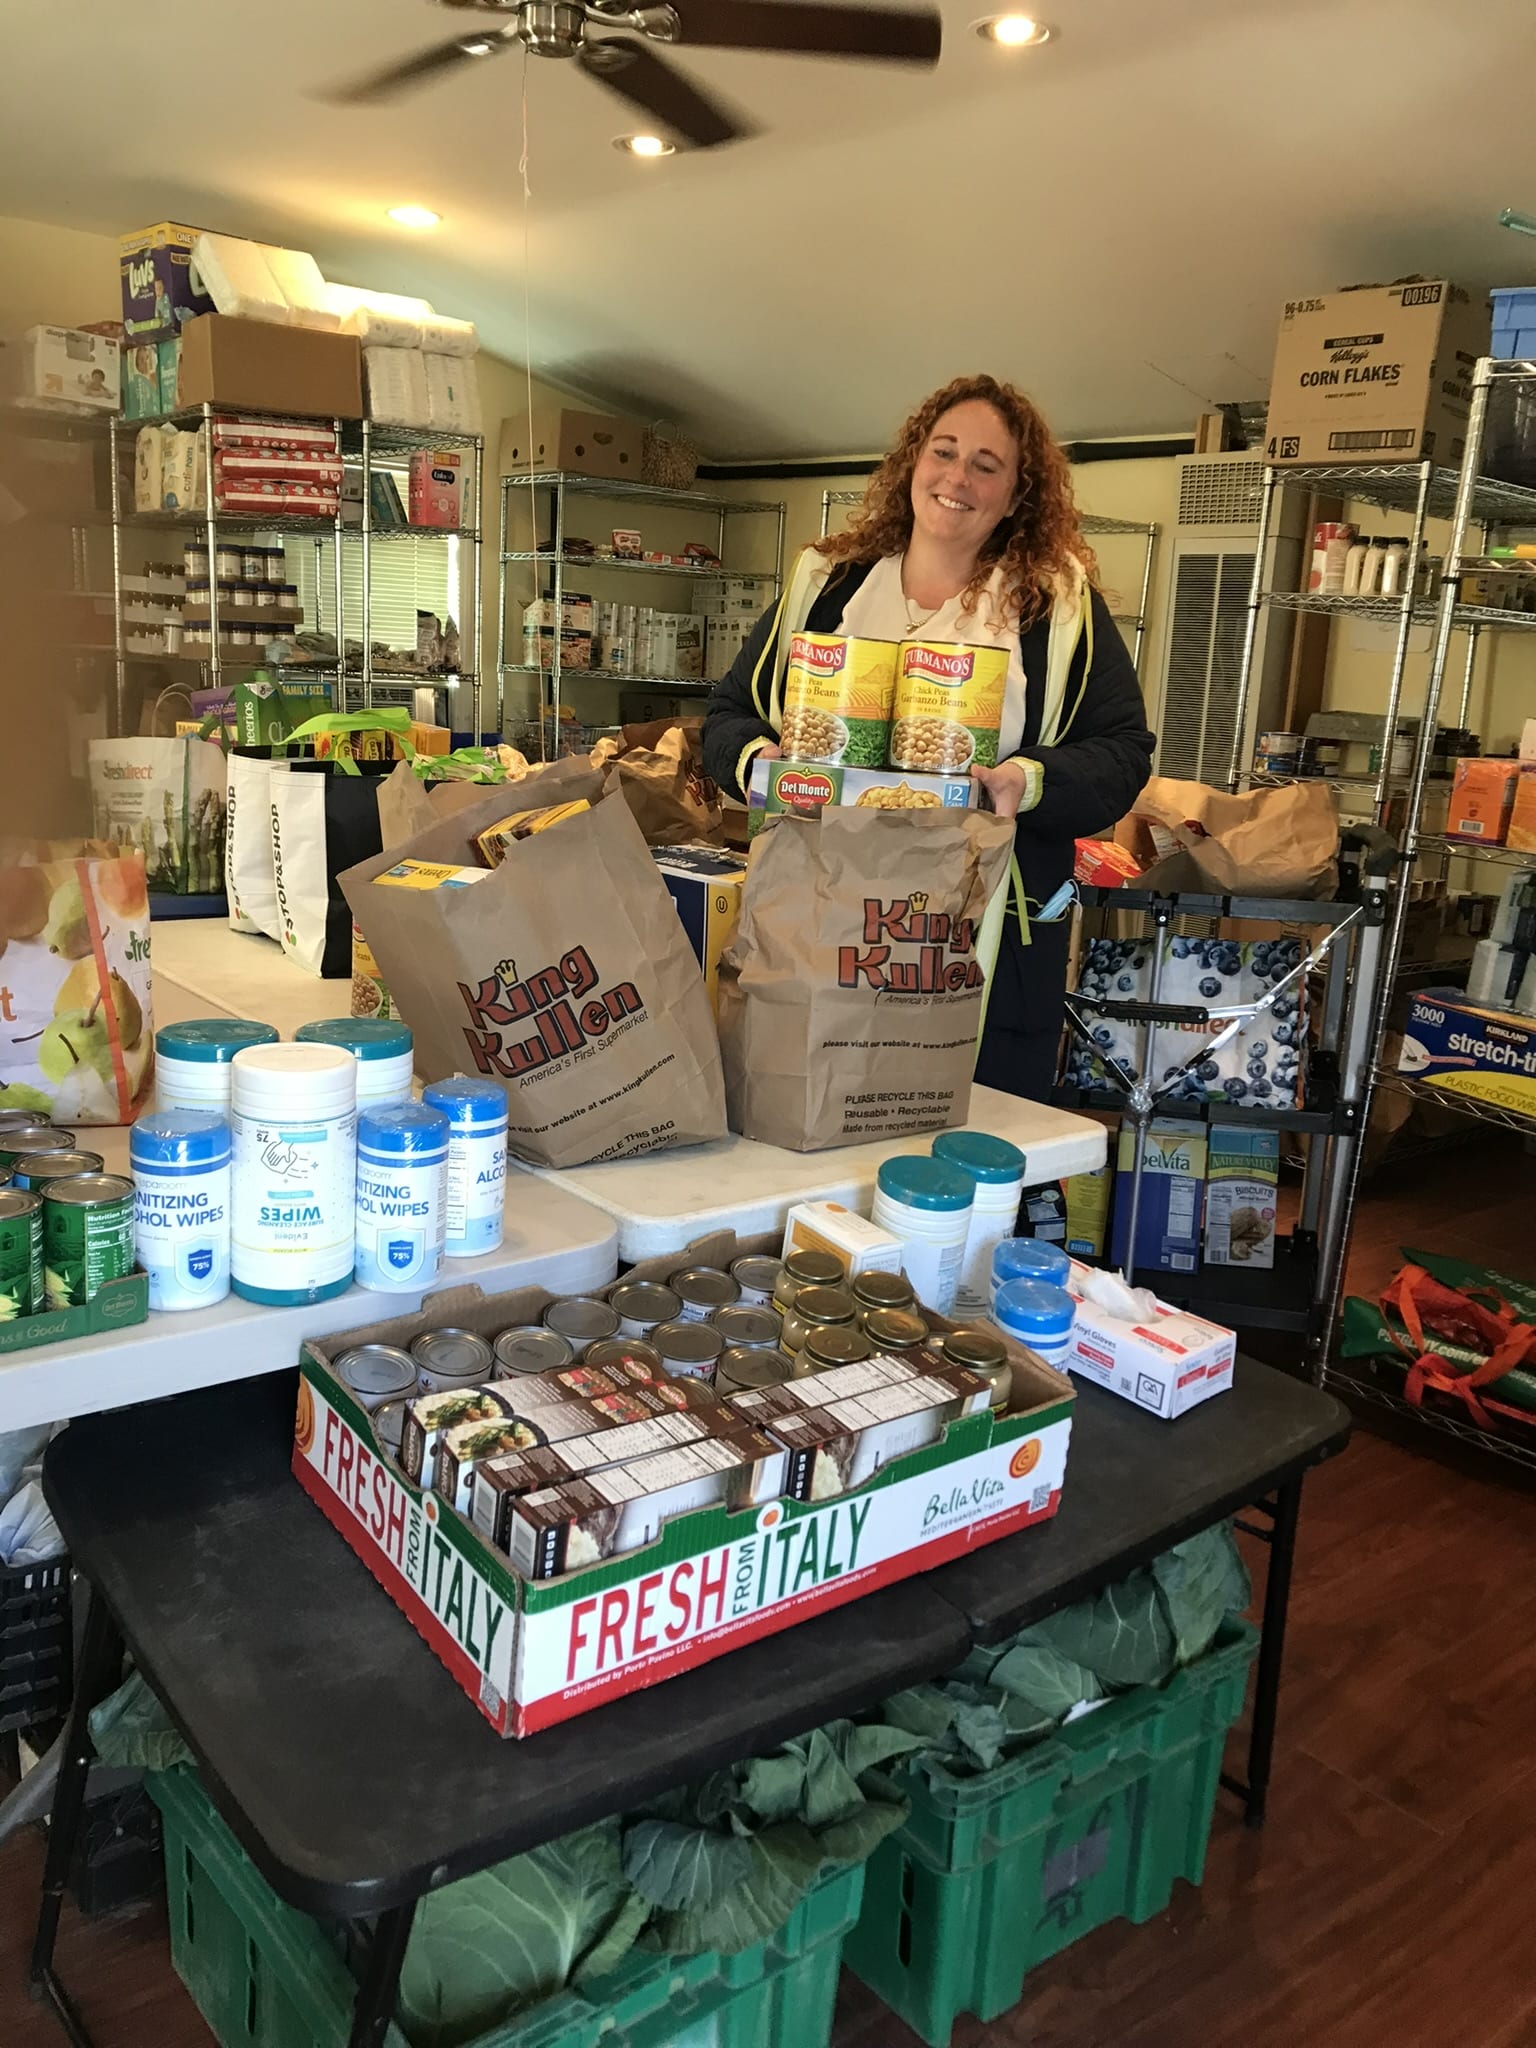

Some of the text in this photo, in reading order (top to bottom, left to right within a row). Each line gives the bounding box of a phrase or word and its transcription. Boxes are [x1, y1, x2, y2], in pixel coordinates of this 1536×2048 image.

[1404, 286, 1440, 305] 00196
[1333, 335, 1374, 347] CEREAL CUPS
[1330, 349, 1370, 364] Kellogg's
[1300, 364, 1401, 387] CORN FLAKES
[1268, 437, 1299, 458] 4 FS
[792, 638, 844, 667] URMANO'S
[904, 648, 971, 677] FURMANO'S
[808, 677, 823, 686] Peas
[282, 685, 325, 696] FAMILY SIZE
[813, 687, 840, 698] Beans
[913, 686, 950, 697] Chick Peas
[901, 693, 968, 709] Garbanzo Beans
[244, 701, 254, 746] heerios
[780, 781, 831, 798] Del Monte
[947, 785, 964, 802] 12
[271, 803, 295, 931] STOP&SHOP
[863, 891, 979, 955] King
[456, 944, 600, 1031] King
[1411, 1004, 1446, 1024] 3000
[462, 982, 644, 1079] Kullen
[1485, 1025, 1529, 1043] KIRKLAND
[519, 1010, 649, 1089] America's First Supermarket
[822, 1041, 848, 1049] please
[850, 1040, 869, 1049] visit
[882, 1040, 911, 1048] website
[911, 1041, 921, 1049] at
[1447, 1033, 1536, 1073] stretch-ti
[1445, 1076, 1483, 1093] PLASTIC
[518, 1126, 534, 1134] visit
[534, 1125, 549, 1134] our
[551, 1107, 587, 1129] website
[587, 1101, 598, 1111] at
[599, 1053, 675, 1105] www.kingkullen.com
[845, 1090, 955, 1105] PLEASE RECYCLE THIS BAG
[844, 1105, 952, 1120] Reusable Recyclable
[624, 1130, 650, 1143] THIS
[650, 1120, 676, 1136] BAG
[842, 1117, 948, 1134] Made from recycled material
[1211, 1155, 1245, 1168] NATURE
[475, 1169, 506, 1185] ALCO
[1234, 1185, 1274, 1199] BISCUITS
[87, 1211, 121, 1223] Nutrition
[176, 1205, 224, 1228] WIPES
[260, 1206, 321, 1222] WIPES
[380, 1200, 430, 1217] WIPES
[87, 1239, 111, 1248] Calories
[393, 1252, 410, 1260] 75%
[192, 1262, 210, 1272] 75%
[27, 1318, 67, 1340] Good
[1091, 1330, 1117, 1349] Gloves
[922, 1487, 969, 1527] Bella
[969, 1477, 1005, 1504] Vita
[323, 1407, 504, 1677] FRESH FROM ITALY
[566, 1496, 874, 1683] FRESH FROM ITALY
[562, 1673, 611, 1700] Distributed
[611, 1669, 624, 1681] by
